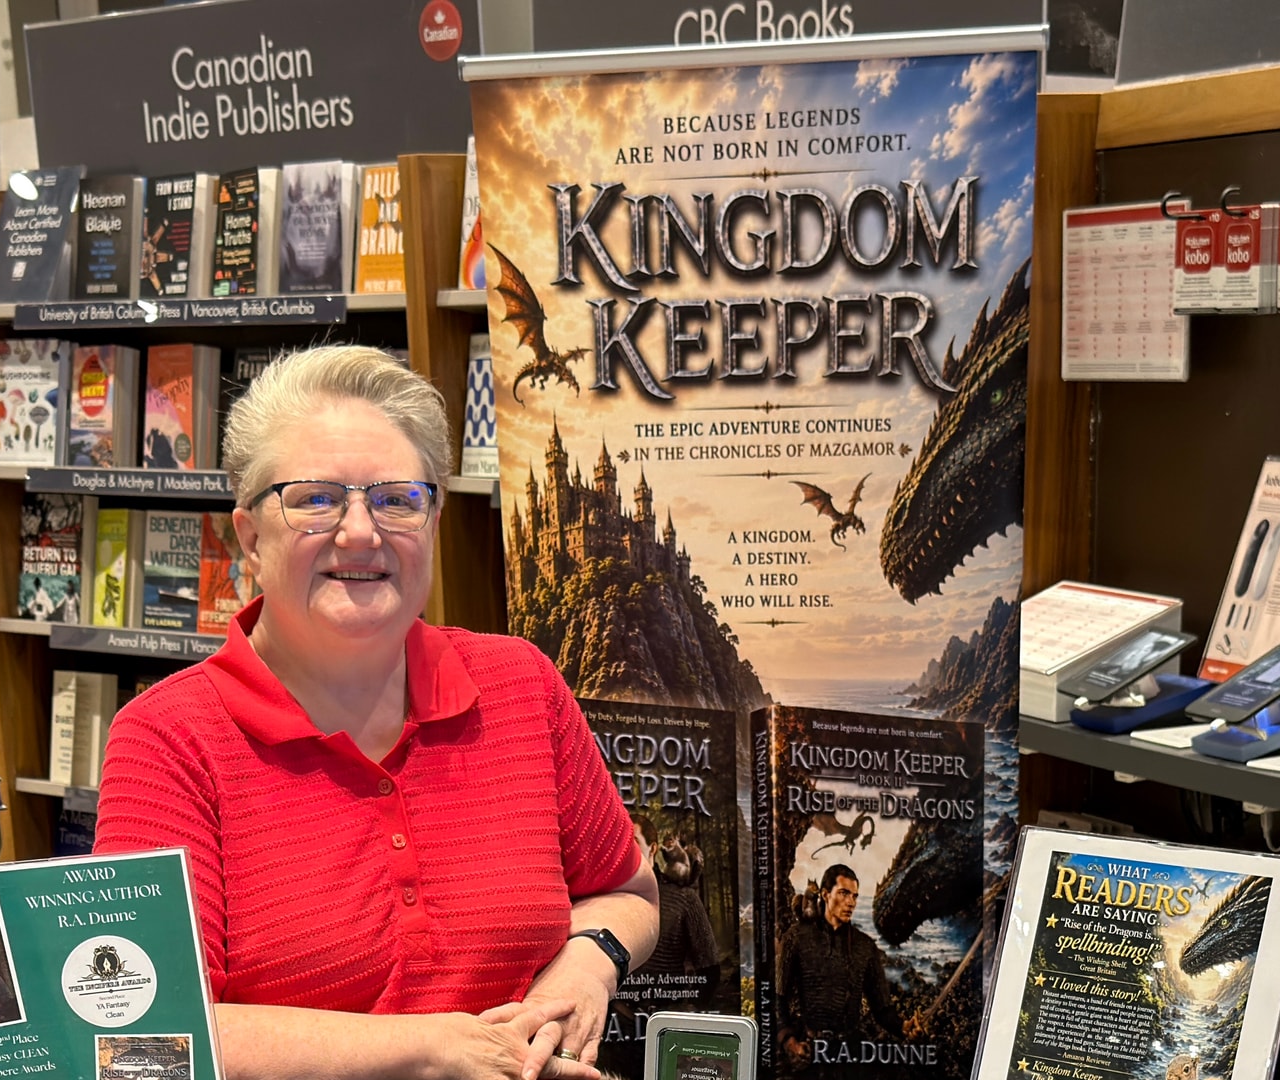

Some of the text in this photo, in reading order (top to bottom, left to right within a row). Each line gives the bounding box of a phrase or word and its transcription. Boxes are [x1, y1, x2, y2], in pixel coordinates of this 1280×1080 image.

[423, 26, 458, 43] Canadian
[172, 33, 313, 90] Canadian
[143, 83, 354, 143] Indie Publishers
[664, 108, 861, 134] BECAUSE LEGENDS
[615, 134, 911, 165] ARE NOT BORN IN COMFORT.
[548, 176, 981, 290] KINGDOM
[586, 291, 958, 400] KEEPER
[634, 418, 892, 437] THE EPIC ADVENTURE CONTINUES
[634, 442, 896, 461] IN THE CHRONICLES OF MAZGAMOR
[728, 530, 816, 544] A KINGDOM.
[732, 552, 811, 565] A DESTINY.
[745, 574, 798, 586] A HERO
[721, 595, 833, 608] WHO WILL RISE.
[63, 867, 116, 884] AWARD
[1108, 863, 1150, 879] WHAT
[25, 883, 162, 909] WINNING AUTHOR
[1051, 865, 1193, 917] READERS
[58, 910, 137, 928] R.A. Dunne
[1072, 904, 1168, 927] ARE SAYING...
[1083, 922, 1093, 931] of
[1093, 922, 1107, 933] the
[1108, 924, 1143, 938] Dragons
[14, 1047, 50, 1060] CLEAN
[20, 1061, 56, 1074] Awards
